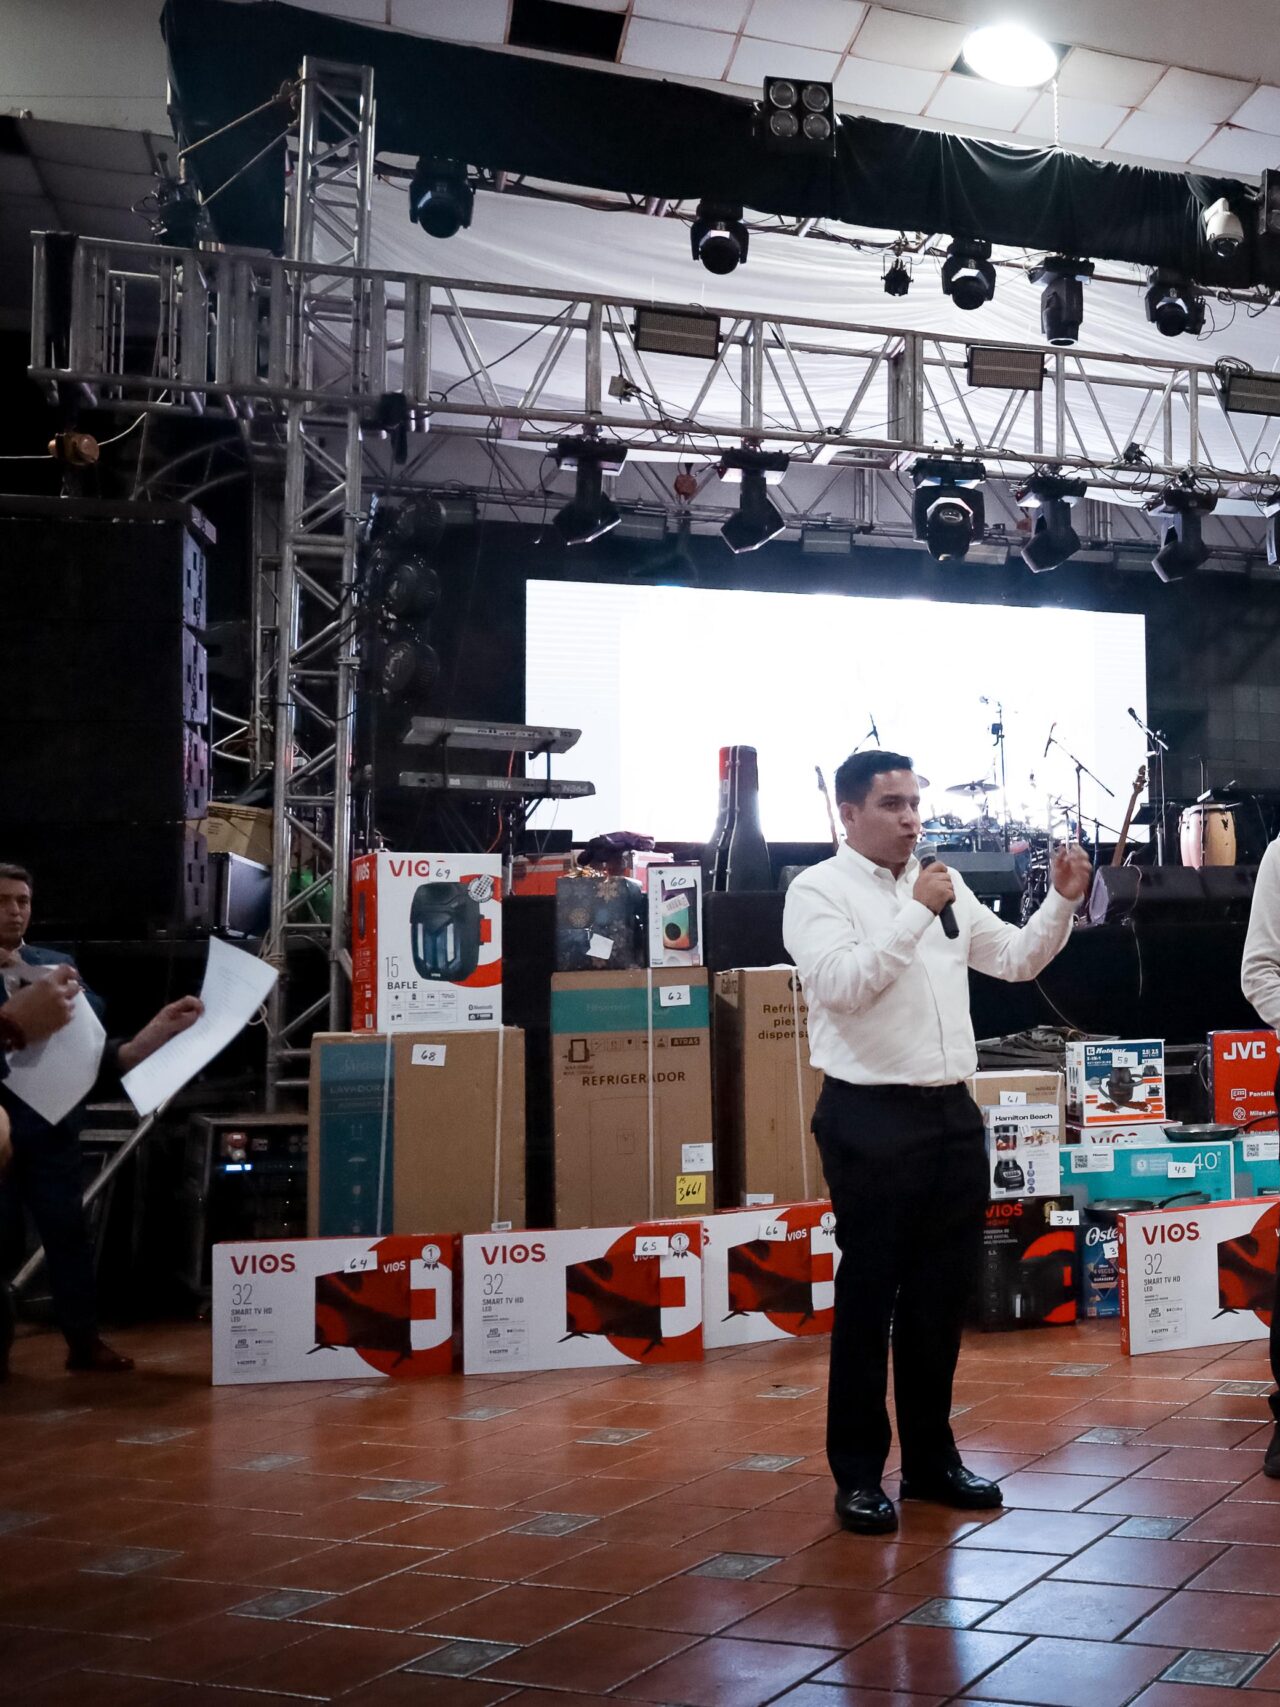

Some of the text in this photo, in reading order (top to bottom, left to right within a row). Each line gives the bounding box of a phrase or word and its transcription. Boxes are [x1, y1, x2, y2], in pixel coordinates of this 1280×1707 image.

[389, 859, 446, 877] VIO
[435, 868, 451, 880] 69
[670, 877, 686, 887] 60
[385, 956, 400, 978] 15
[387, 981, 418, 990] BAFLE
[668, 992, 682, 1000] 62
[763, 1004, 809, 1014] Refrie
[674, 1038, 699, 1046] ATRAS
[421, 1050, 437, 1062] 68
[1223, 1041, 1266, 1060] JVC
[582, 1071, 686, 1087] REFRIGERADOR
[985, 1203, 1023, 1217] VIOS
[787, 1229, 807, 1241] VIOS
[1085, 1226, 1119, 1246] Oste
[1142, 1222, 1200, 1245] VIOS
[481, 1243, 546, 1265] VIOS
[1109, 1247, 1117, 1255] 3
[231, 1253, 296, 1275] VIOS
[349, 1258, 367, 1270] 64
[383, 1260, 406, 1274] VIOS
[1144, 1253, 1162, 1275] 32
[484, 1273, 503, 1295] 32
[1144, 1277, 1162, 1286] SMART
[232, 1283, 253, 1305] 32
